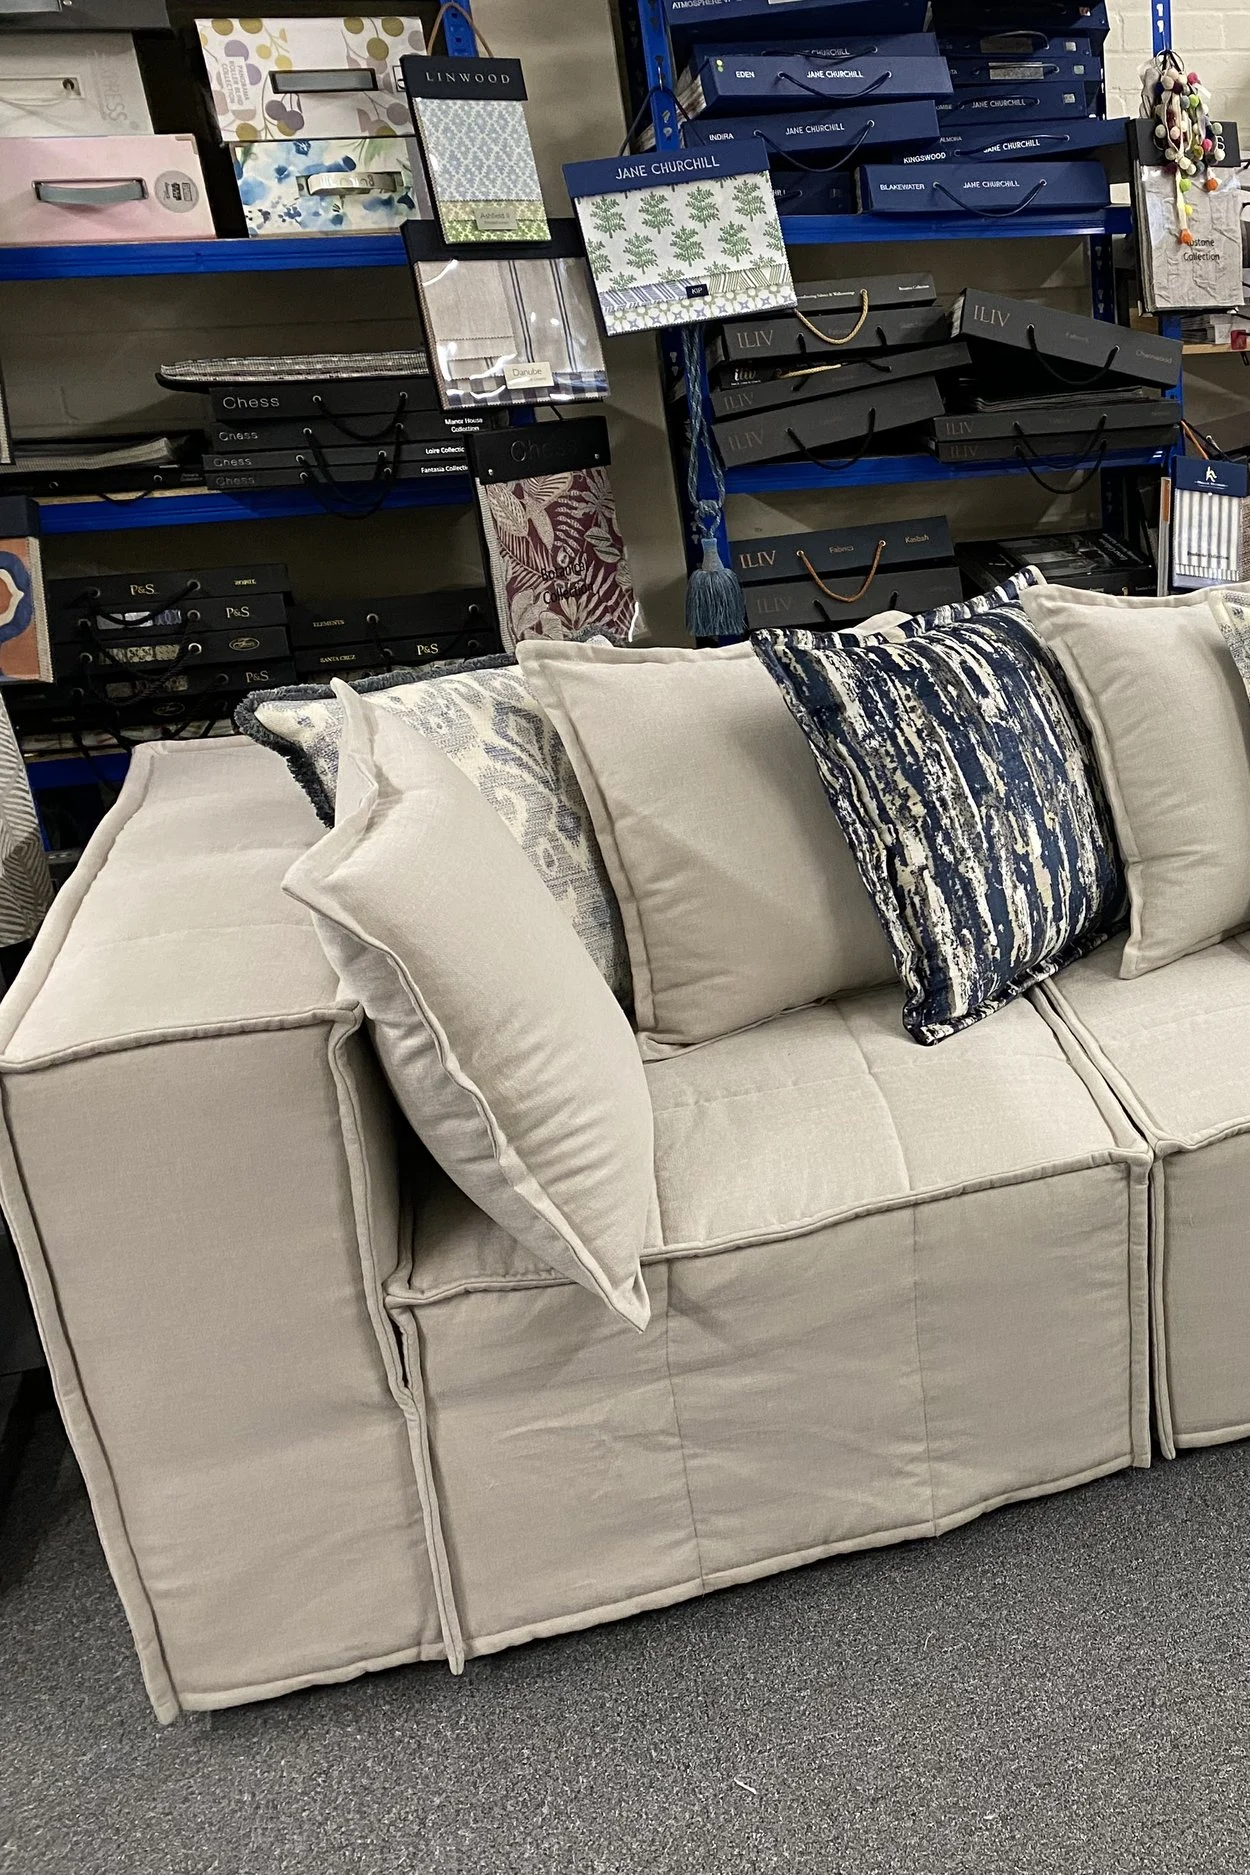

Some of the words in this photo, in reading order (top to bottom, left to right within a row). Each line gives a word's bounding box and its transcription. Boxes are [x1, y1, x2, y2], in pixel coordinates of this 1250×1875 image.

[425, 71, 510, 84] LINWOOD
[735, 71, 755, 79] EDEN
[806, 71, 825, 79] JANE
[825, 70, 864, 79] CHURCHILL
[971, 101, 988, 109] JANE
[989, 99, 1026, 108] CHURCHILL
[784, 127, 804, 136] JANE
[805, 124, 844, 134] CHURCHILL
[708, 133, 734, 141] INDIRA
[1002, 138, 1041, 151] CHURCHILL
[903, 152, 946, 164] KINGSWOOD
[615, 164, 648, 180] JANE
[650, 155, 720, 176] CHURCHILL
[879, 183, 925, 191] BLAKEWATER
[962, 180, 981, 189] JANE
[982, 179, 1020, 188] CHURCHILL
[1183, 251, 1220, 262] Collection
[691, 286, 703, 295] KIP
[973, 305, 1011, 328] ILIV
[736, 329, 773, 349] ILIV
[512, 368, 542, 377] Danube
[222, 395, 280, 410] Chess
[723, 392, 755, 411] ILIV
[464, 416, 483, 425] House
[945, 420, 974, 436] ILIV
[218, 430, 258, 442] Chess
[728, 429, 765, 451] ILIV
[425, 447, 440, 456] Loire
[441, 445, 465, 455] Collectio
[213, 456, 252, 467] Chess
[421, 465, 446, 475] Fantasia
[214, 475, 256, 487] Chess
[904, 534, 930, 544] Kasbah
[738, 550, 776, 569] ILIV
[540, 560, 588, 581] Botanical
[130, 583, 155, 596] P&S
[543, 582, 594, 605] Collection
[226, 606, 250, 618] P&S
[417, 643, 439, 656] P&S
[319, 655, 339, 664] SANTA
[339, 654, 356, 663] CRUZ
[245, 670, 269, 683] P&S
